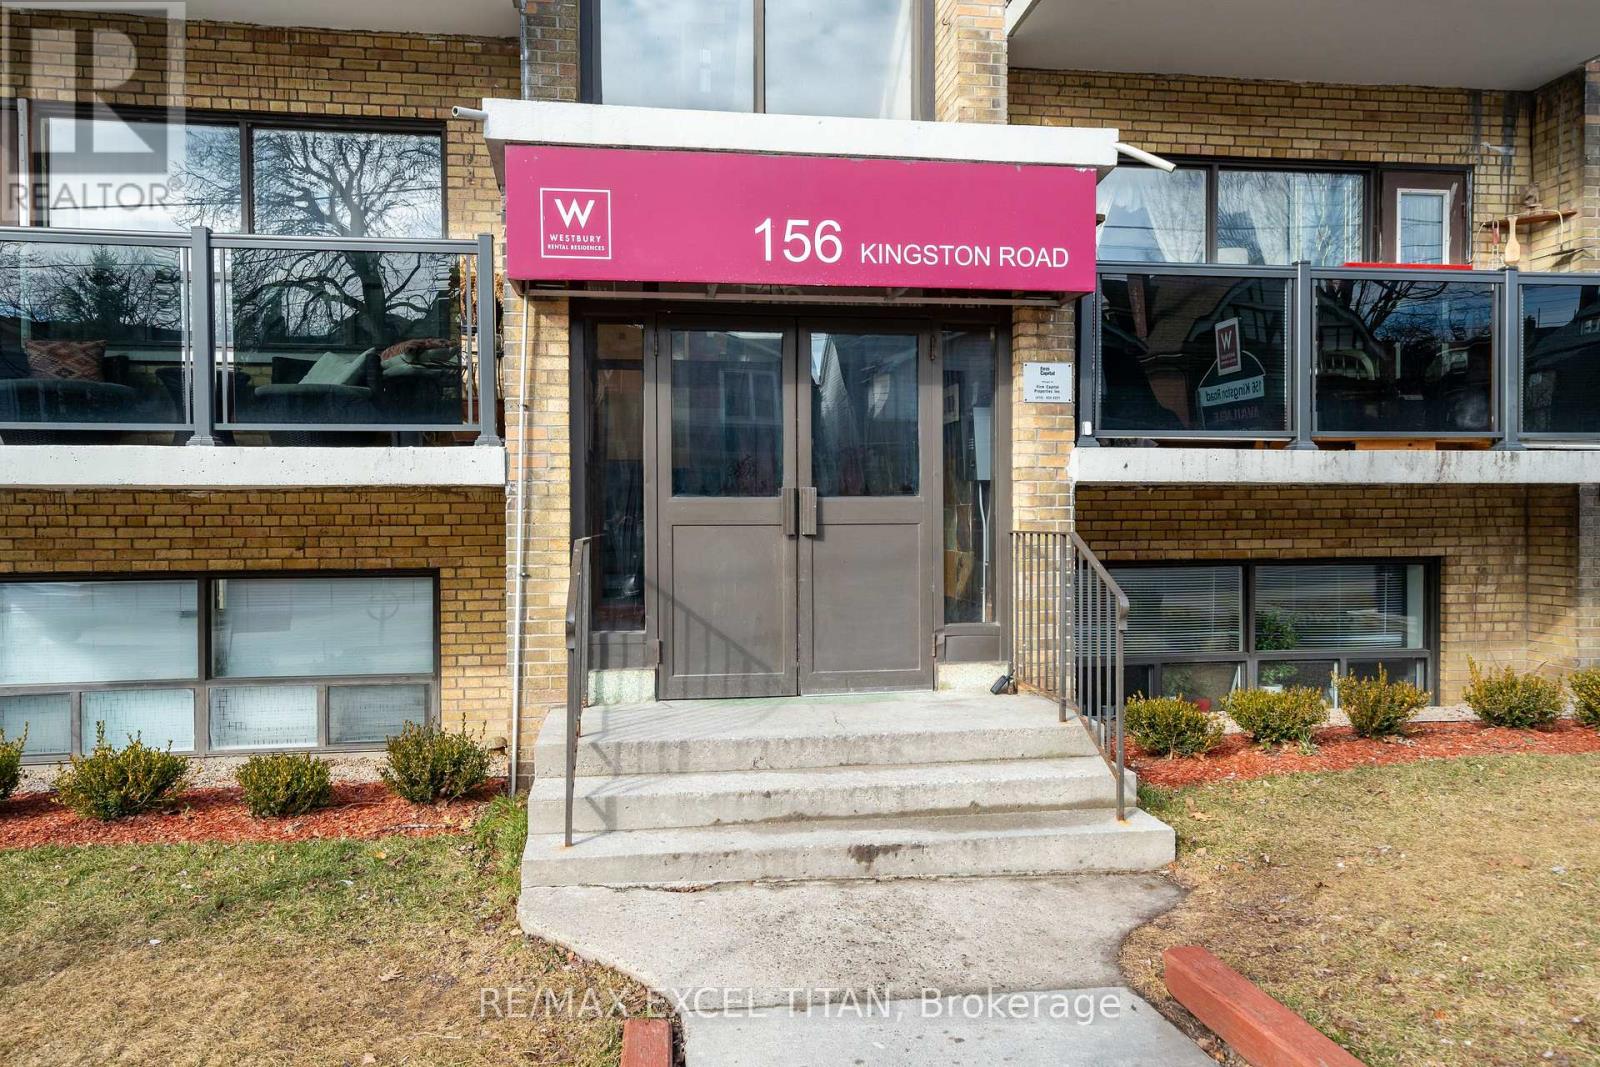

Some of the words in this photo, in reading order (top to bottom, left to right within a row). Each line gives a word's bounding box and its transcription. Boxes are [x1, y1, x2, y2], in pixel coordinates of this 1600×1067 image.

[554, 197, 595, 229] W
[549, 233, 601, 243] WESTBURY
[754, 217, 843, 264] 156
[860, 243, 991, 267] KINGSTON
[999, 247, 1069, 268] ROAD
